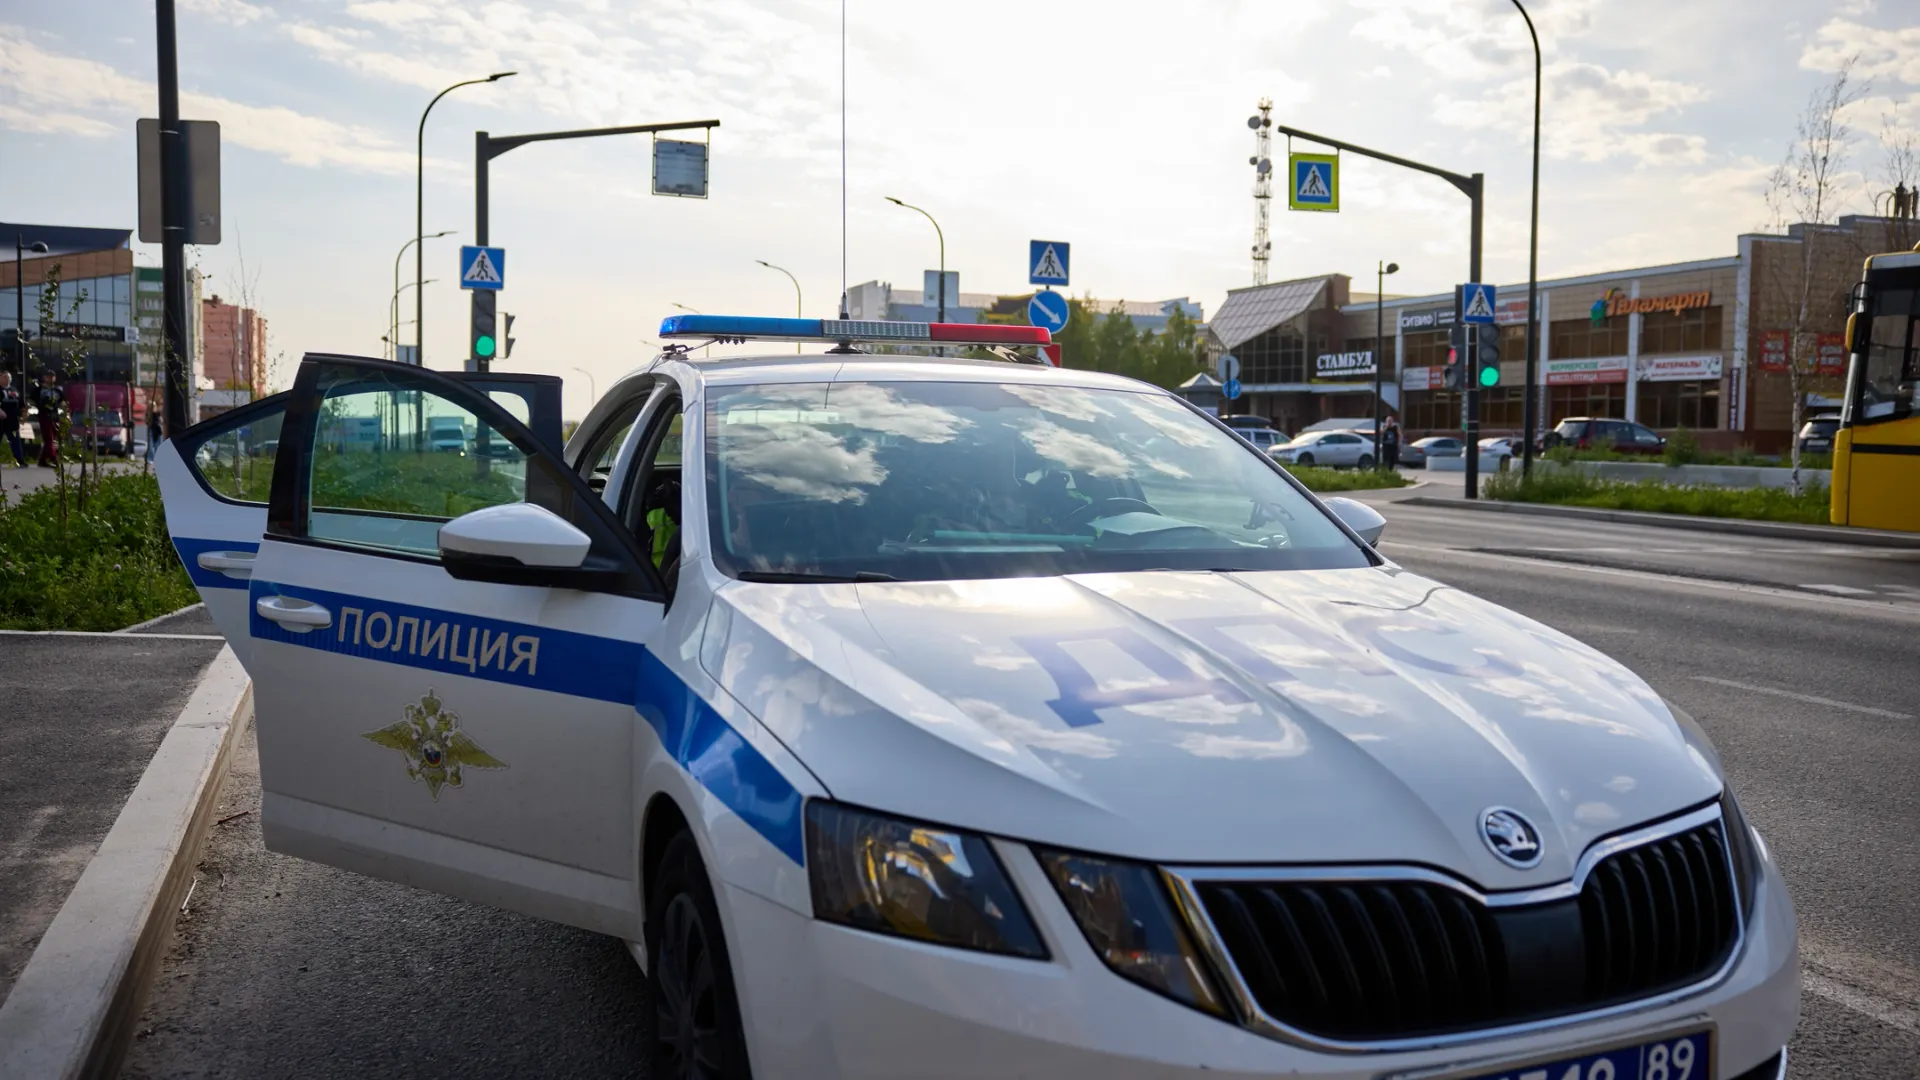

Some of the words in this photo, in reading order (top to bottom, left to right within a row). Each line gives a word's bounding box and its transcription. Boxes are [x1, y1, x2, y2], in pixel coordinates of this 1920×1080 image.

[1316, 351, 1372, 369] СТАМБУЛ
[337, 606, 540, 676] ПОЛИЦИЯ
[1012, 613, 1526, 728] ДПС
[1646, 1038, 1696, 1080] 89
